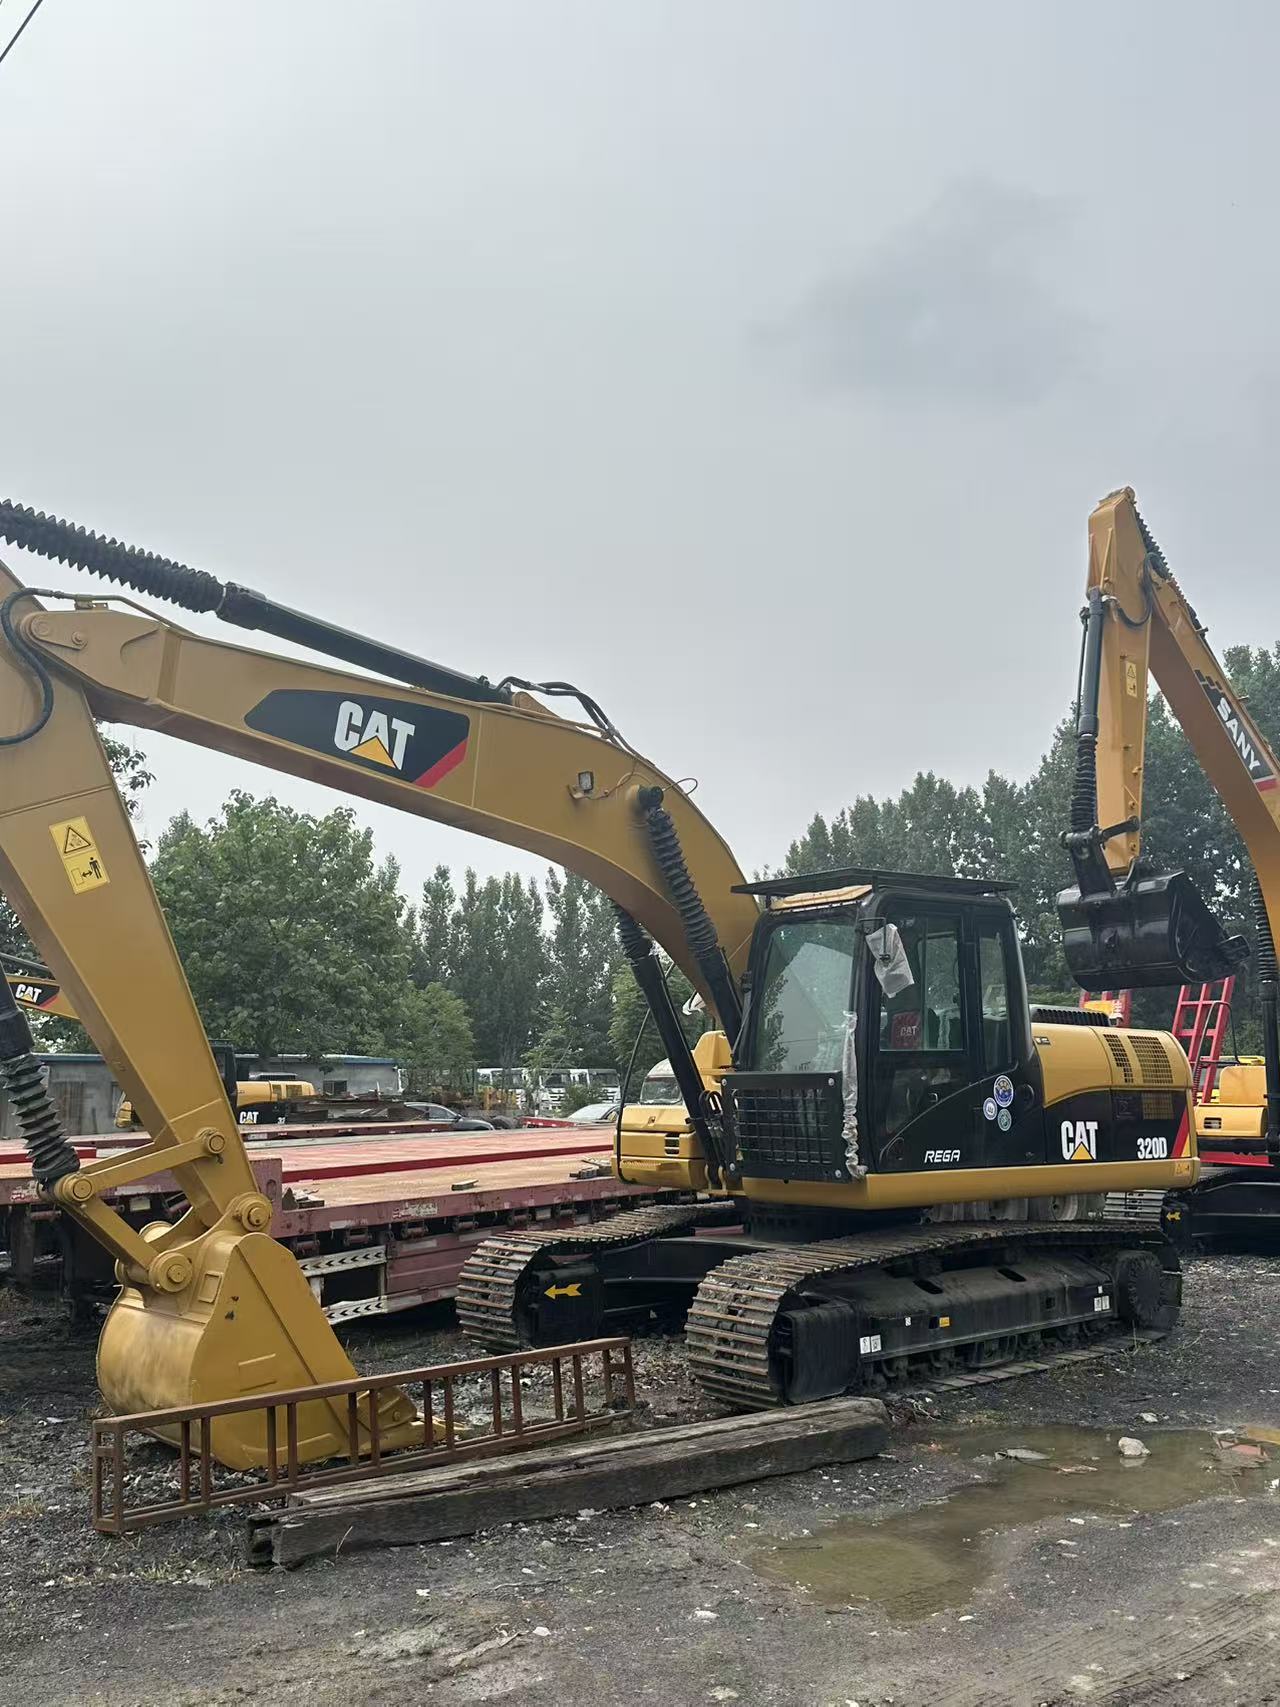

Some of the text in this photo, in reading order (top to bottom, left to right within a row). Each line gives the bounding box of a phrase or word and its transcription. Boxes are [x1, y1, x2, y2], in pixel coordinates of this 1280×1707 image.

[333, 700, 415, 770] CAT
[1217, 697, 1260, 771] SANY
[15, 983, 42, 1003] CAT
[239, 1111, 259, 1124] CAT
[1060, 1120, 1099, 1161] CAT
[1136, 1137, 1168, 1160] 320D
[924, 1149, 961, 1163] REGA
